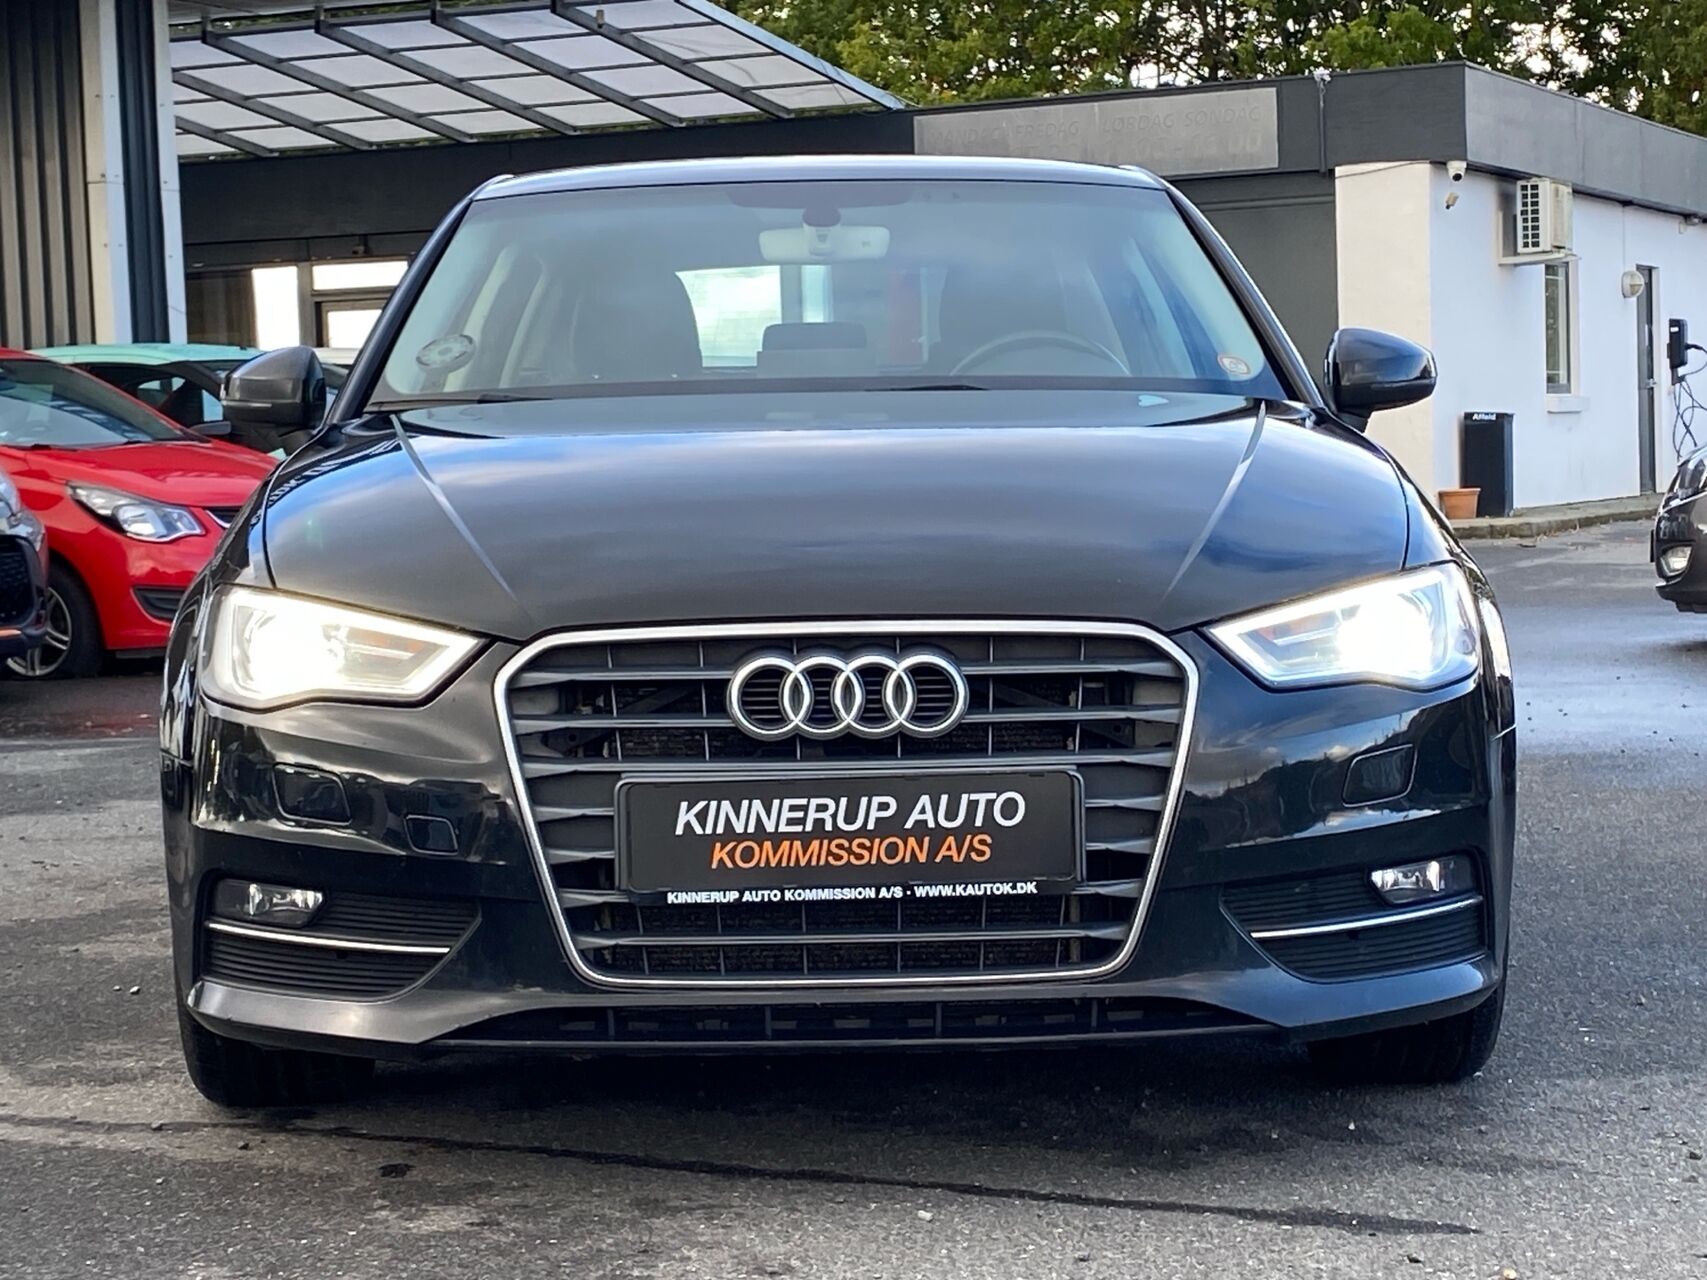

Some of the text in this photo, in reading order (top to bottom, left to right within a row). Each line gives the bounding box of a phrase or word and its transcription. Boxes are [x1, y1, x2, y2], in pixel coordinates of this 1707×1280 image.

[1016, 121, 1079, 138] FREDAG
[675, 791, 1025, 835] KINNERUP AUTO
[711, 833, 992, 869] KOMMISSION A/S
[667, 890, 739, 904] KINNERUP
[742, 889, 781, 902] AUTO
[784, 886, 876, 901] KOMMISSION
[878, 885, 903, 899] A/S
[914, 881, 1038, 898] WWW.KAUTOK.DK
